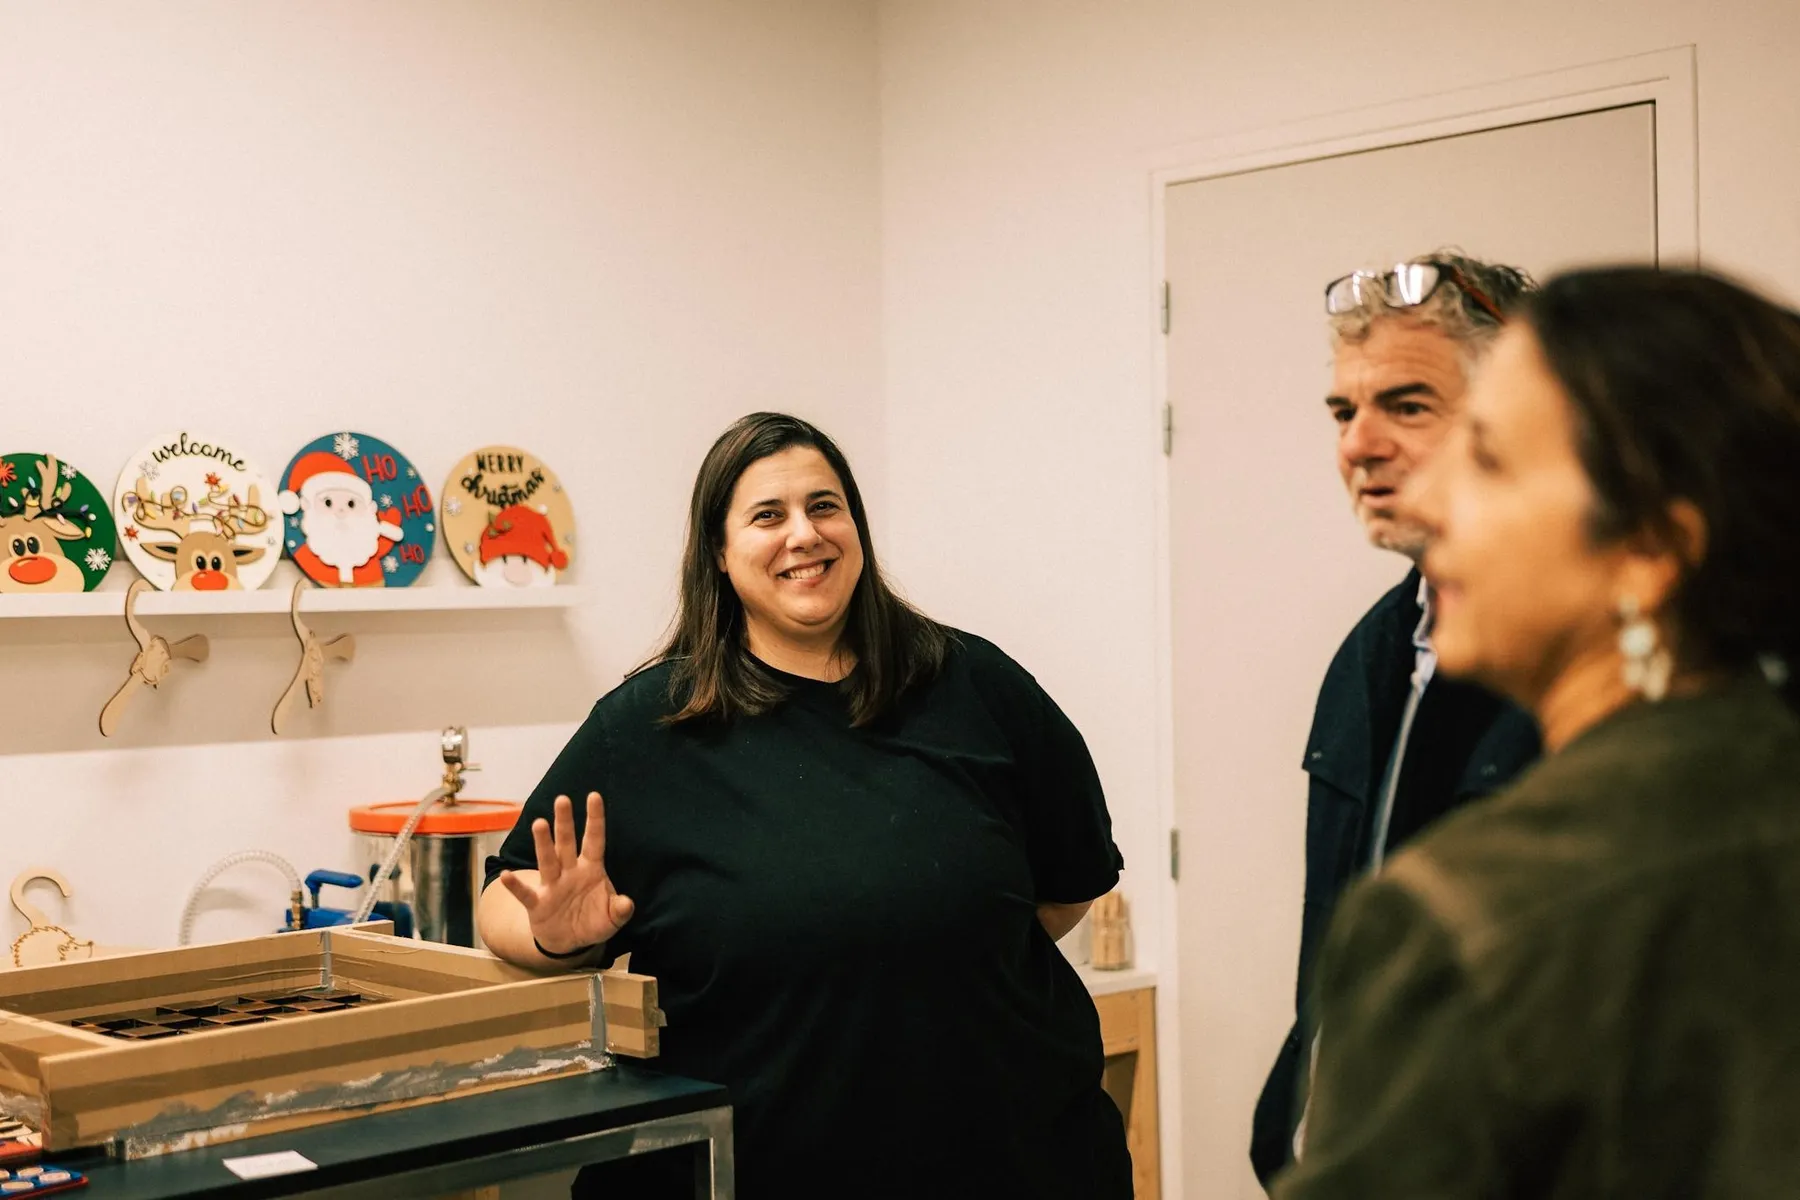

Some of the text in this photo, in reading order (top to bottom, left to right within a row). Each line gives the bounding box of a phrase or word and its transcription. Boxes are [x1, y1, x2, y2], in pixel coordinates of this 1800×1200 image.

[152, 432, 246, 472] welcome
[475, 453, 524, 473] MERRY
[361, 453, 397, 484] HO
[401, 484, 433, 518] HO
[399, 543, 425, 564] HO
